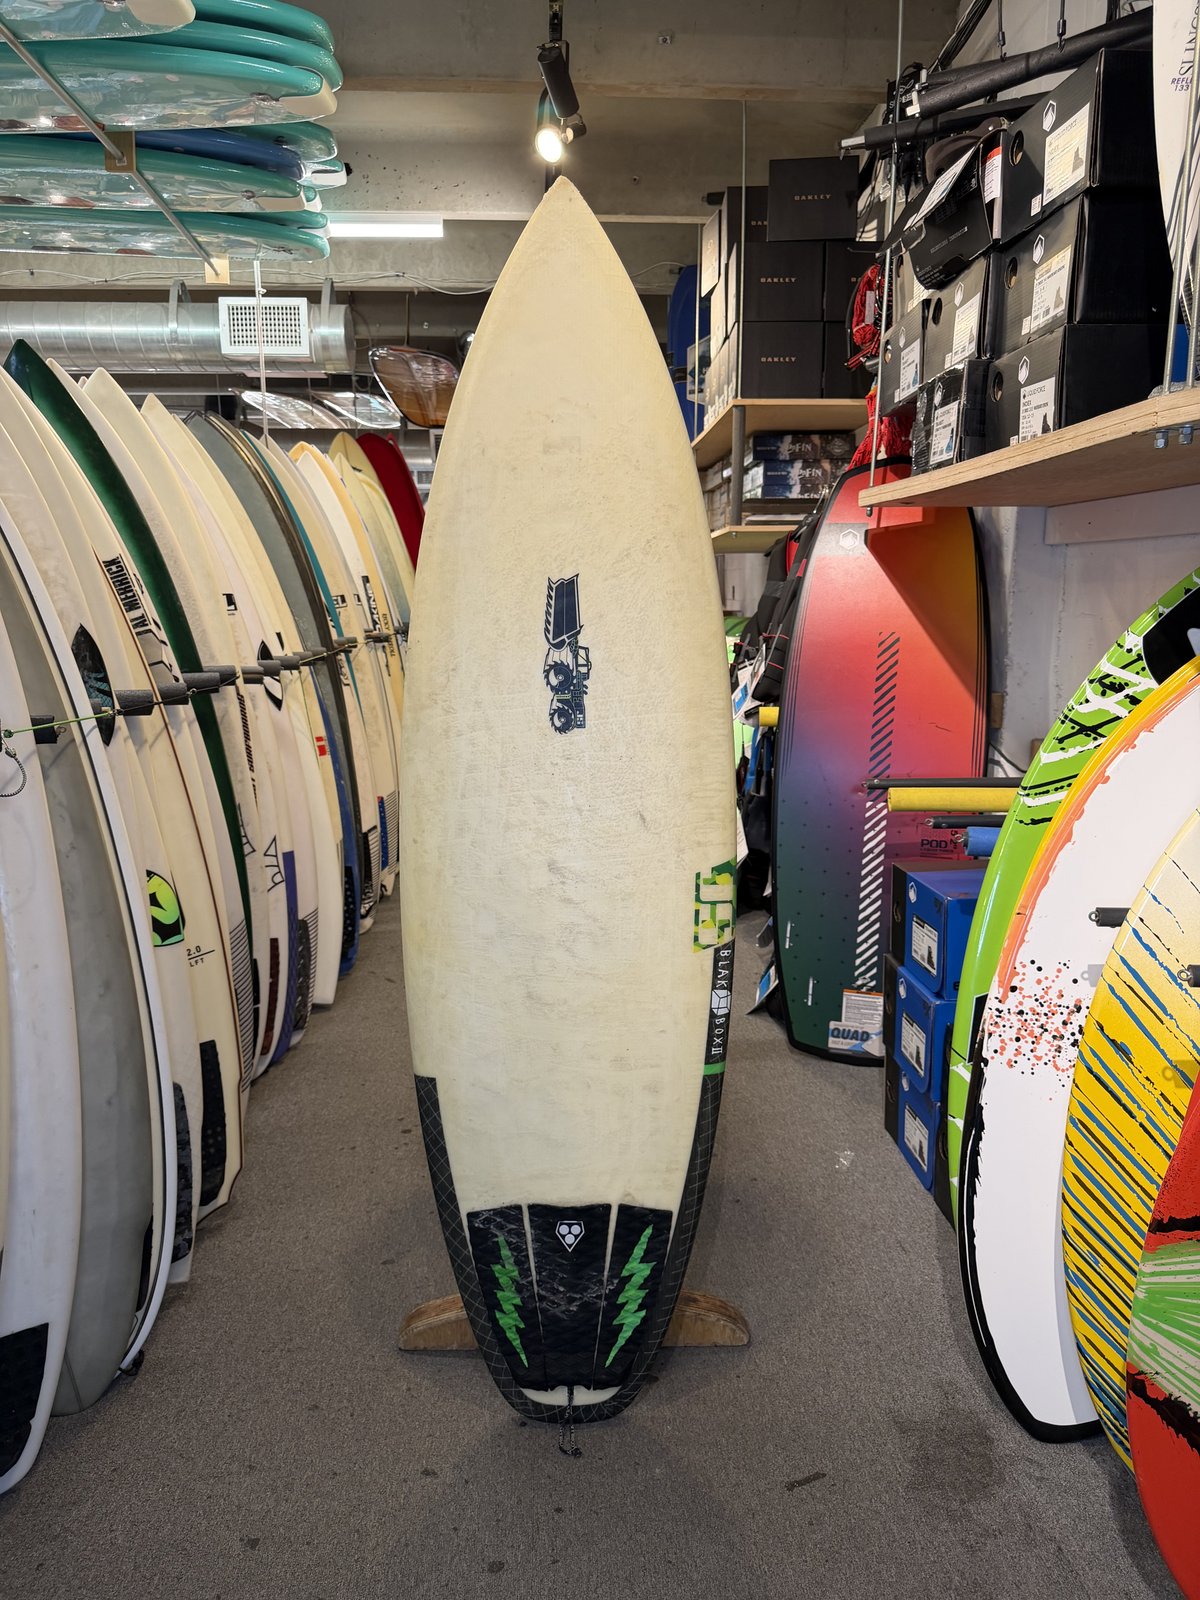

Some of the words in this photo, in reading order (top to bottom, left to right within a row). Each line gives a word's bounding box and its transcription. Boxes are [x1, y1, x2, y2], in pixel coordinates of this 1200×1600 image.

[1174, 84, 1190, 92] 133
[102, 555, 142, 613] MERRICK
[130, 613, 149, 630] AL
[920, 838, 948, 849] POD
[186, 945, 202, 957] 2.0
[189, 957, 205, 968] LFT
[716, 949, 732, 988] BLAK
[831, 1027, 870, 1042] QUAD
